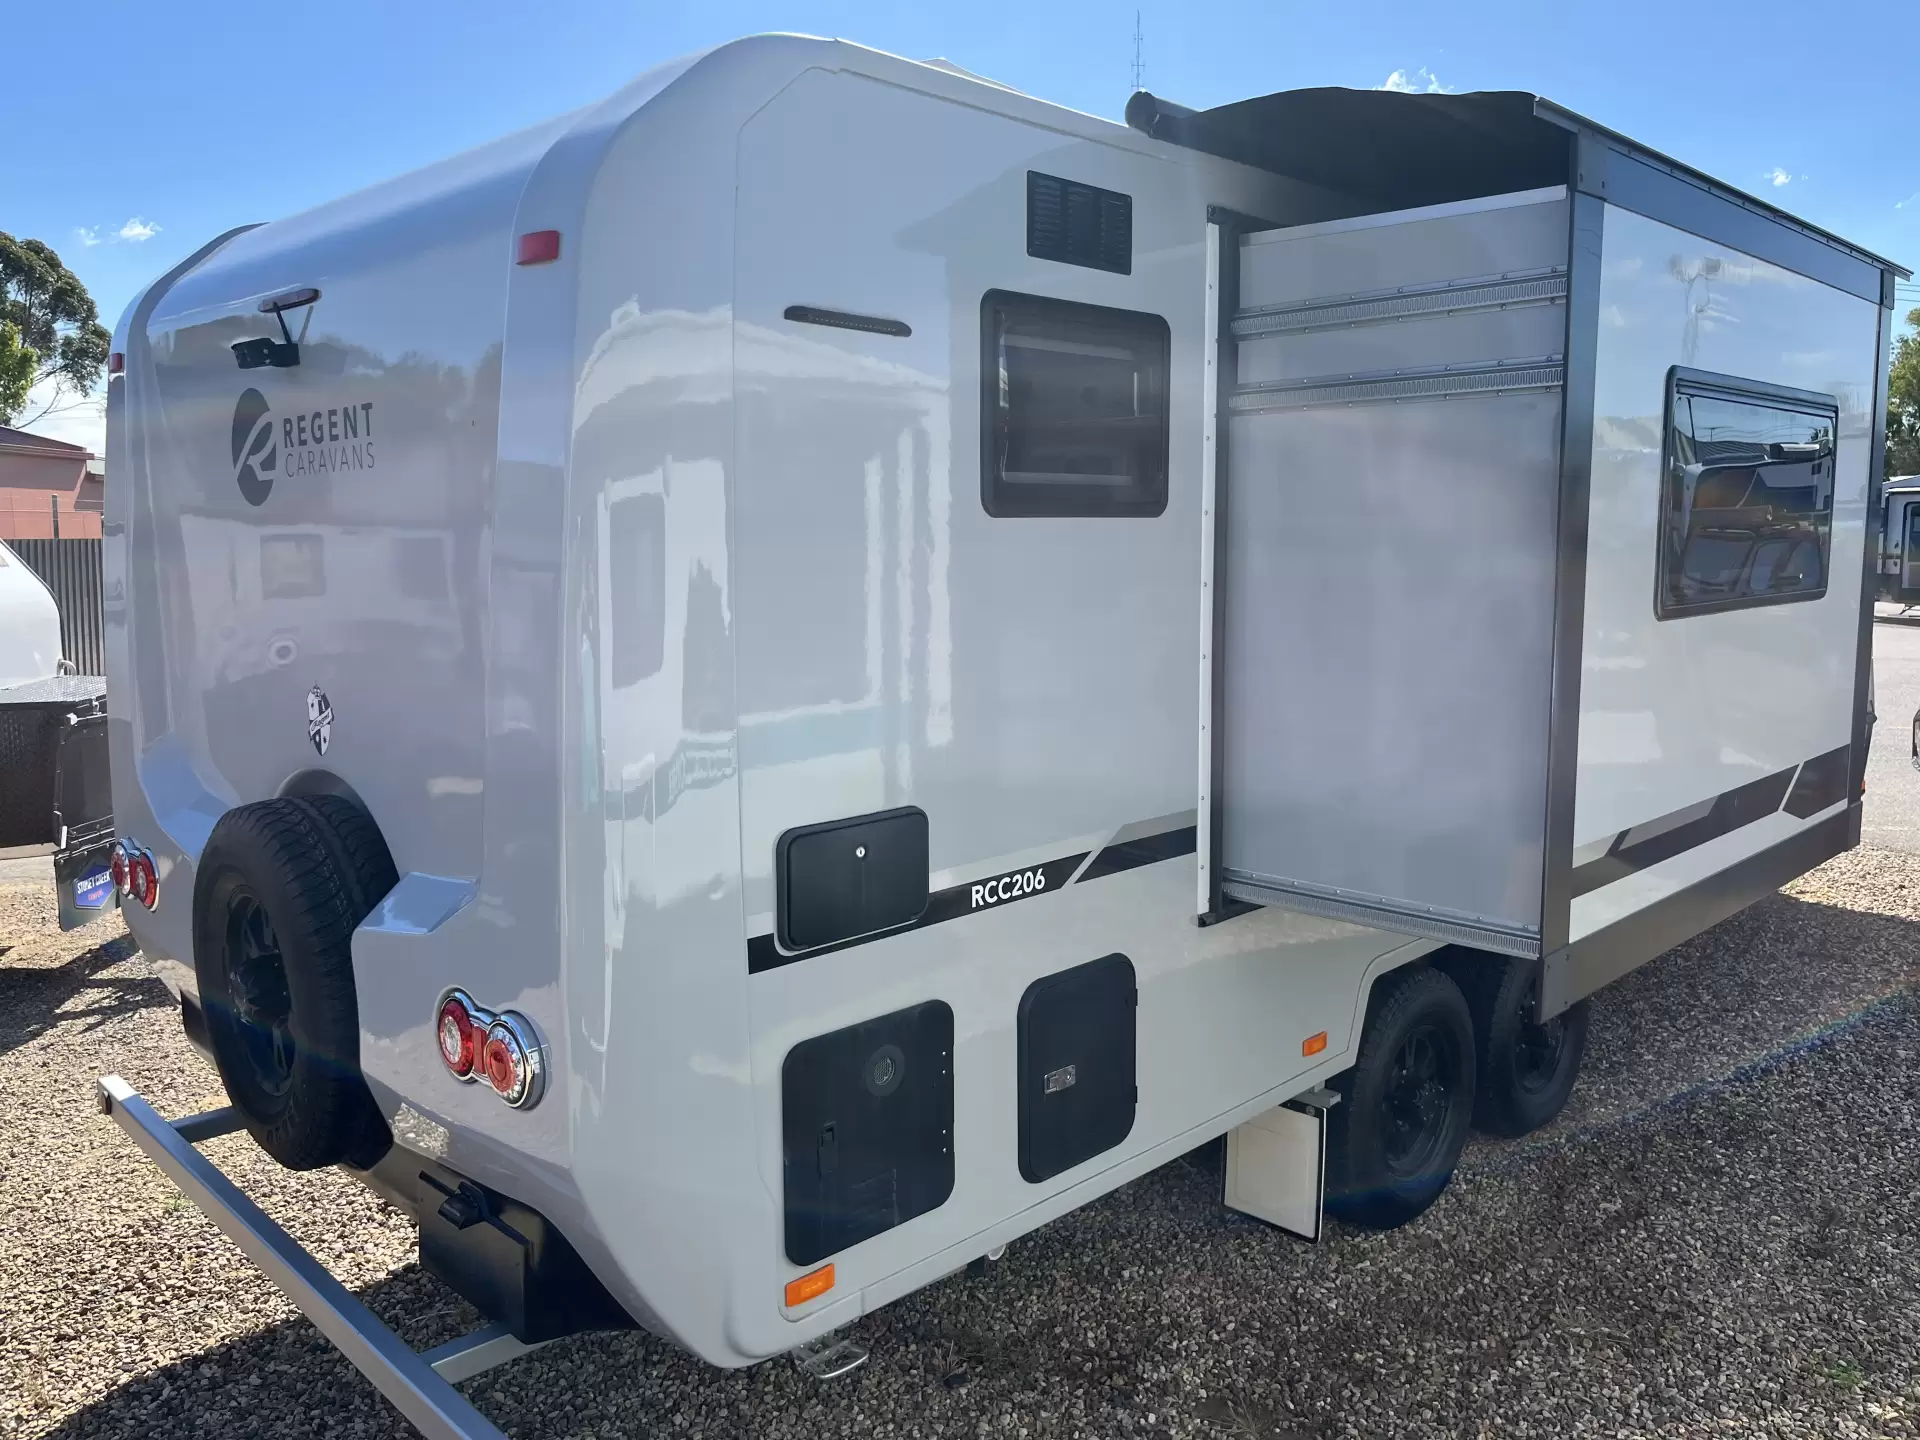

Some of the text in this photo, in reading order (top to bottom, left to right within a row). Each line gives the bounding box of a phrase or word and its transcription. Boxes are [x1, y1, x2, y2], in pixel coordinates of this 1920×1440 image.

[283, 402, 373, 449] REGENT
[285, 442, 375, 478] CARAVANS
[971, 868, 1046, 908] RCC206
